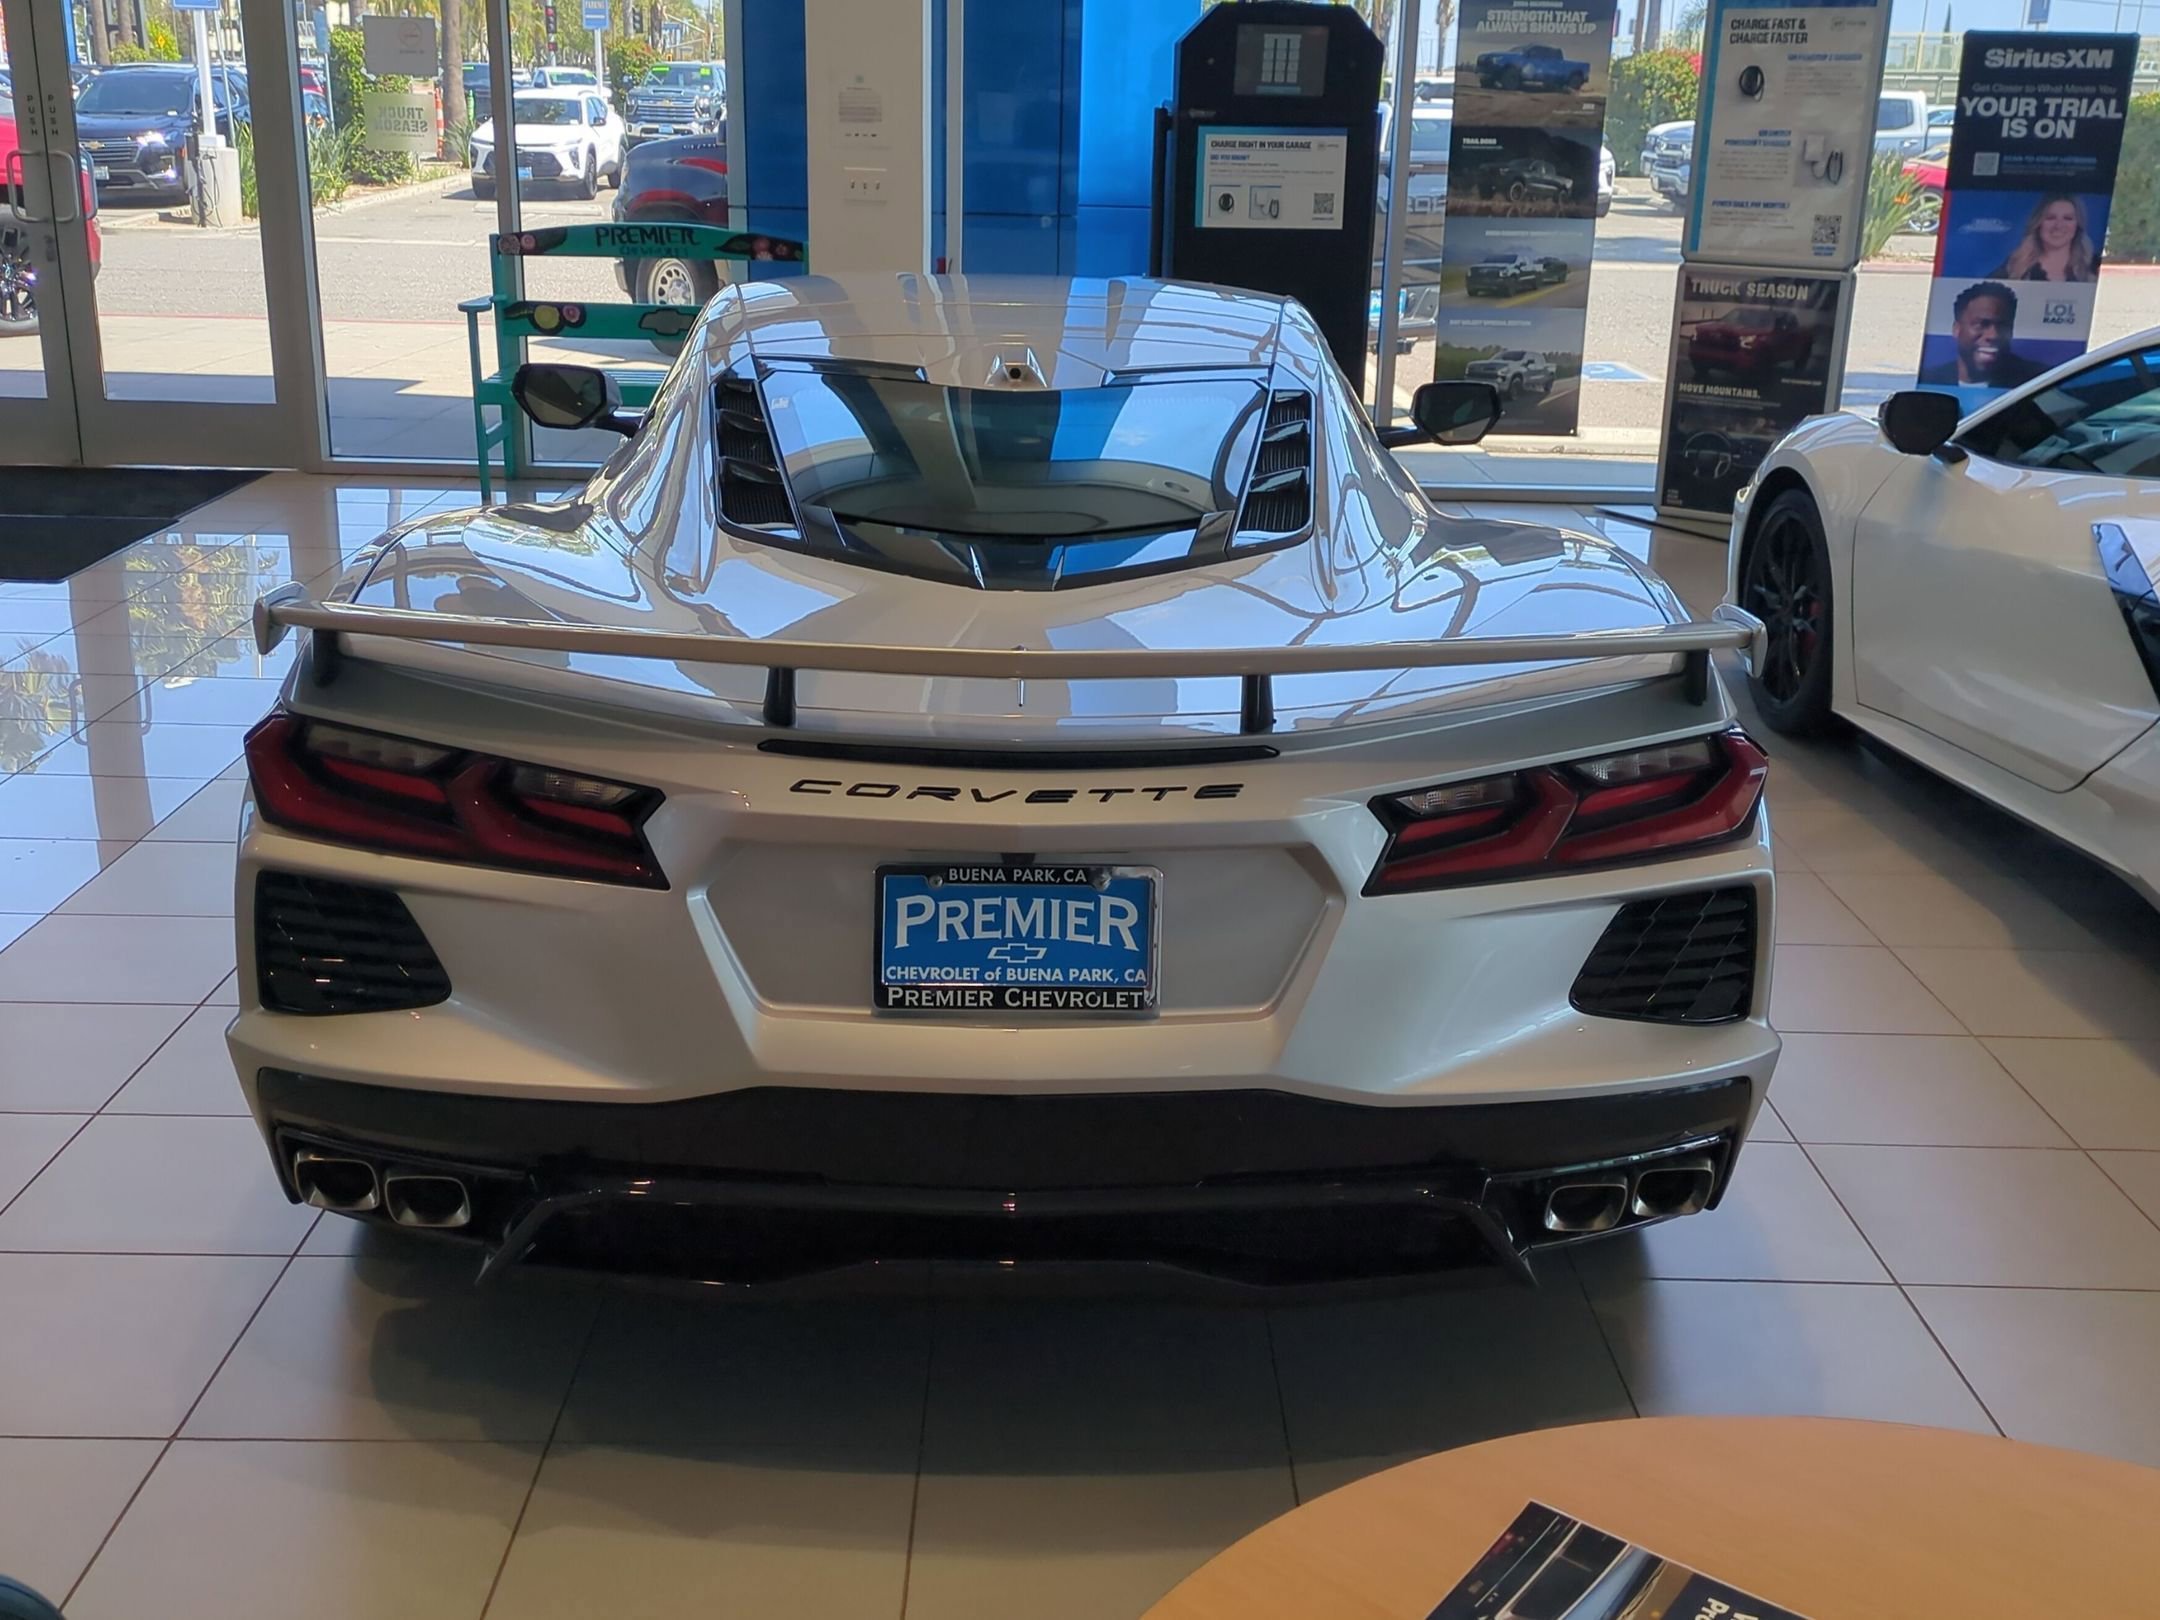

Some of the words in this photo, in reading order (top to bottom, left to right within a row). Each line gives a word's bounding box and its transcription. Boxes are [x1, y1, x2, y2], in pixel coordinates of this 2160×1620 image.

[1486, 9, 1553, 22] STRENGTH
[1555, 11, 1589, 23] THAT
[1730, 18, 1770, 31] CHARGE
[1771, 18, 1796, 30] FAST
[1798, 18, 1806, 30] &
[1476, 20, 1529, 33] ALWAYS
[1529, 21, 1578, 34] SHOWS
[1580, 23, 1597, 35] UP
[1729, 31, 1769, 45] CHARGE
[1770, 32, 1809, 44] FASTER
[1984, 48, 2114, 69] SiriusXM
[1972, 82, 1990, 93] Get
[2037, 83, 2063, 94] What
[1961, 96, 2037, 117] YOUR
[2044, 97, 2123, 119] TRIAL
[2001, 118, 2028, 138] IS
[2034, 118, 2076, 139] ON
[1210, 140, 1237, 149] CHARGE
[595, 226, 702, 247] PREMIER
[1691, 278, 1741, 296] TRUCK
[1746, 282, 1809, 301] SEASON
[1678, 382, 1703, 394] MOVE
[1705, 384, 1761, 400] MOUNTAINS.
[789, 779, 1244, 803] CORVETTE
[949, 868, 1006, 882] BUENA
[894, 894, 1140, 952] PREMIER
[886, 966, 979, 981] CHEVROLET
[984, 966, 1002, 982] of
[1006, 967, 1064, 982] BUENA
[1069, 968, 1119, 984] PARK,
[1124, 968, 1147, 983] CA
[887, 987, 994, 1008] PREMIER
[1004, 987, 1144, 1009] CHEVROLET
